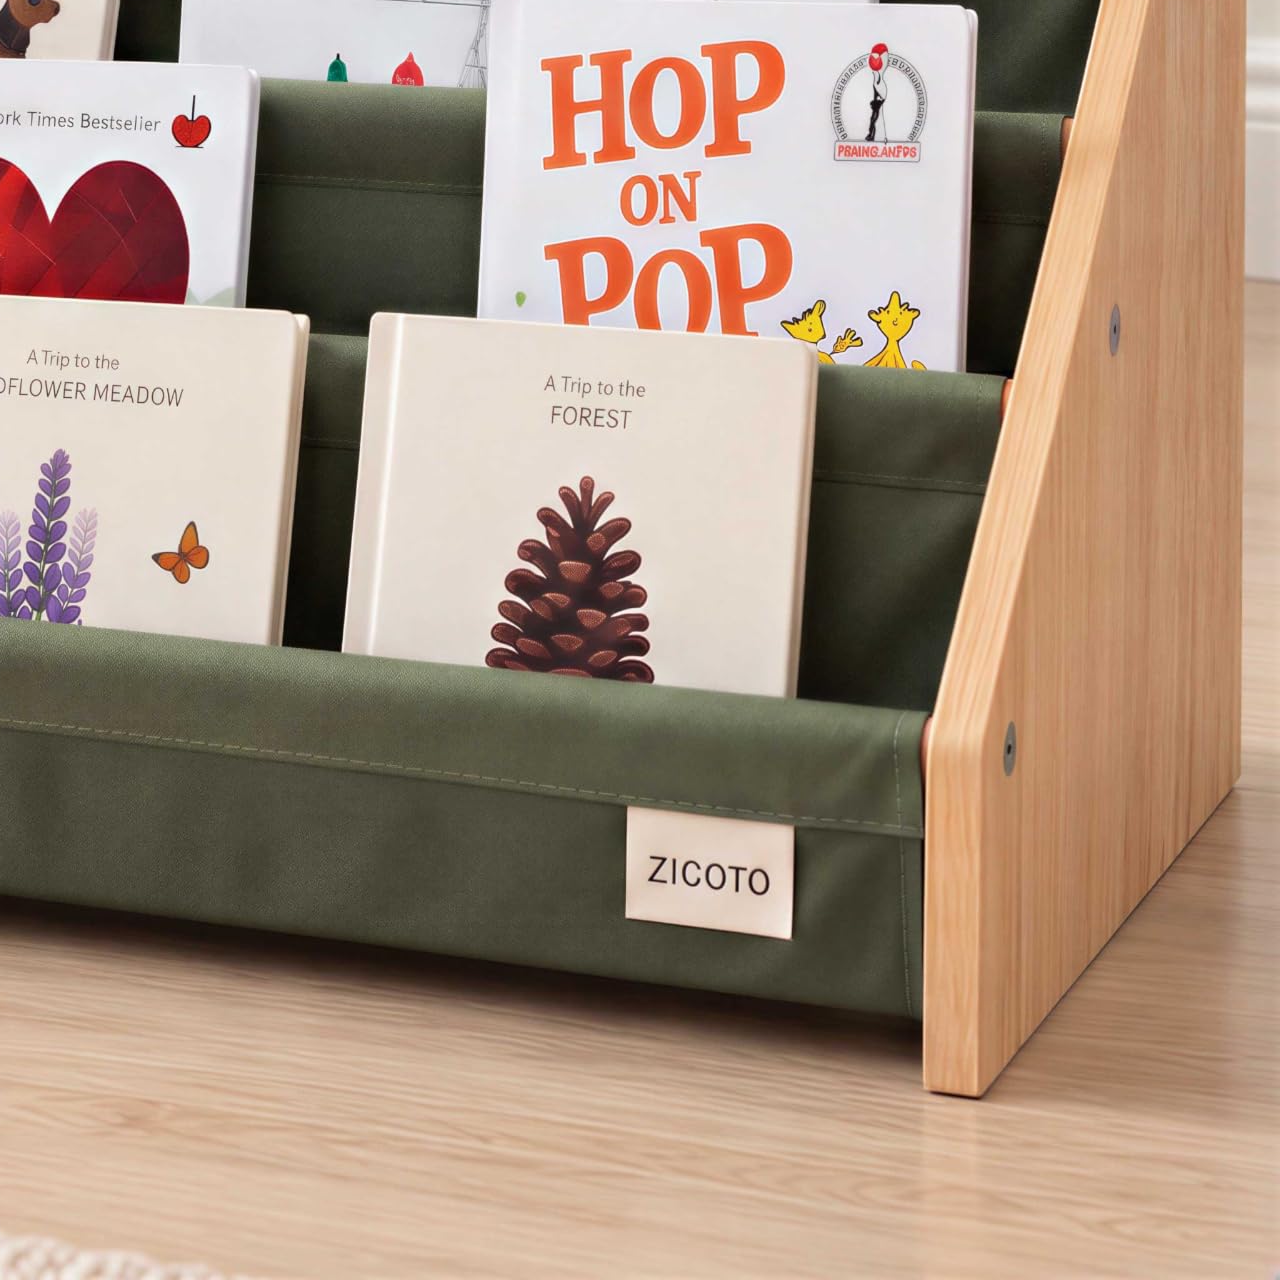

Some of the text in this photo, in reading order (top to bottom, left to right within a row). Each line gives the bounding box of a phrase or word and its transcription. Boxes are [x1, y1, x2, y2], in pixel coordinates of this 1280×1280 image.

[540, 39, 786, 170] HOP
[27, 111, 74, 129] Times
[619, 170, 702, 227] ON
[543, 222, 793, 337] POP
[24, 349, 120, 370] A Trip to the
[93, 383, 184, 408] MEADOW
[544, 375, 646, 398] A Trip to the
[551, 405, 633, 430] FOREST
[647, 855, 770, 896] ZICOTO
